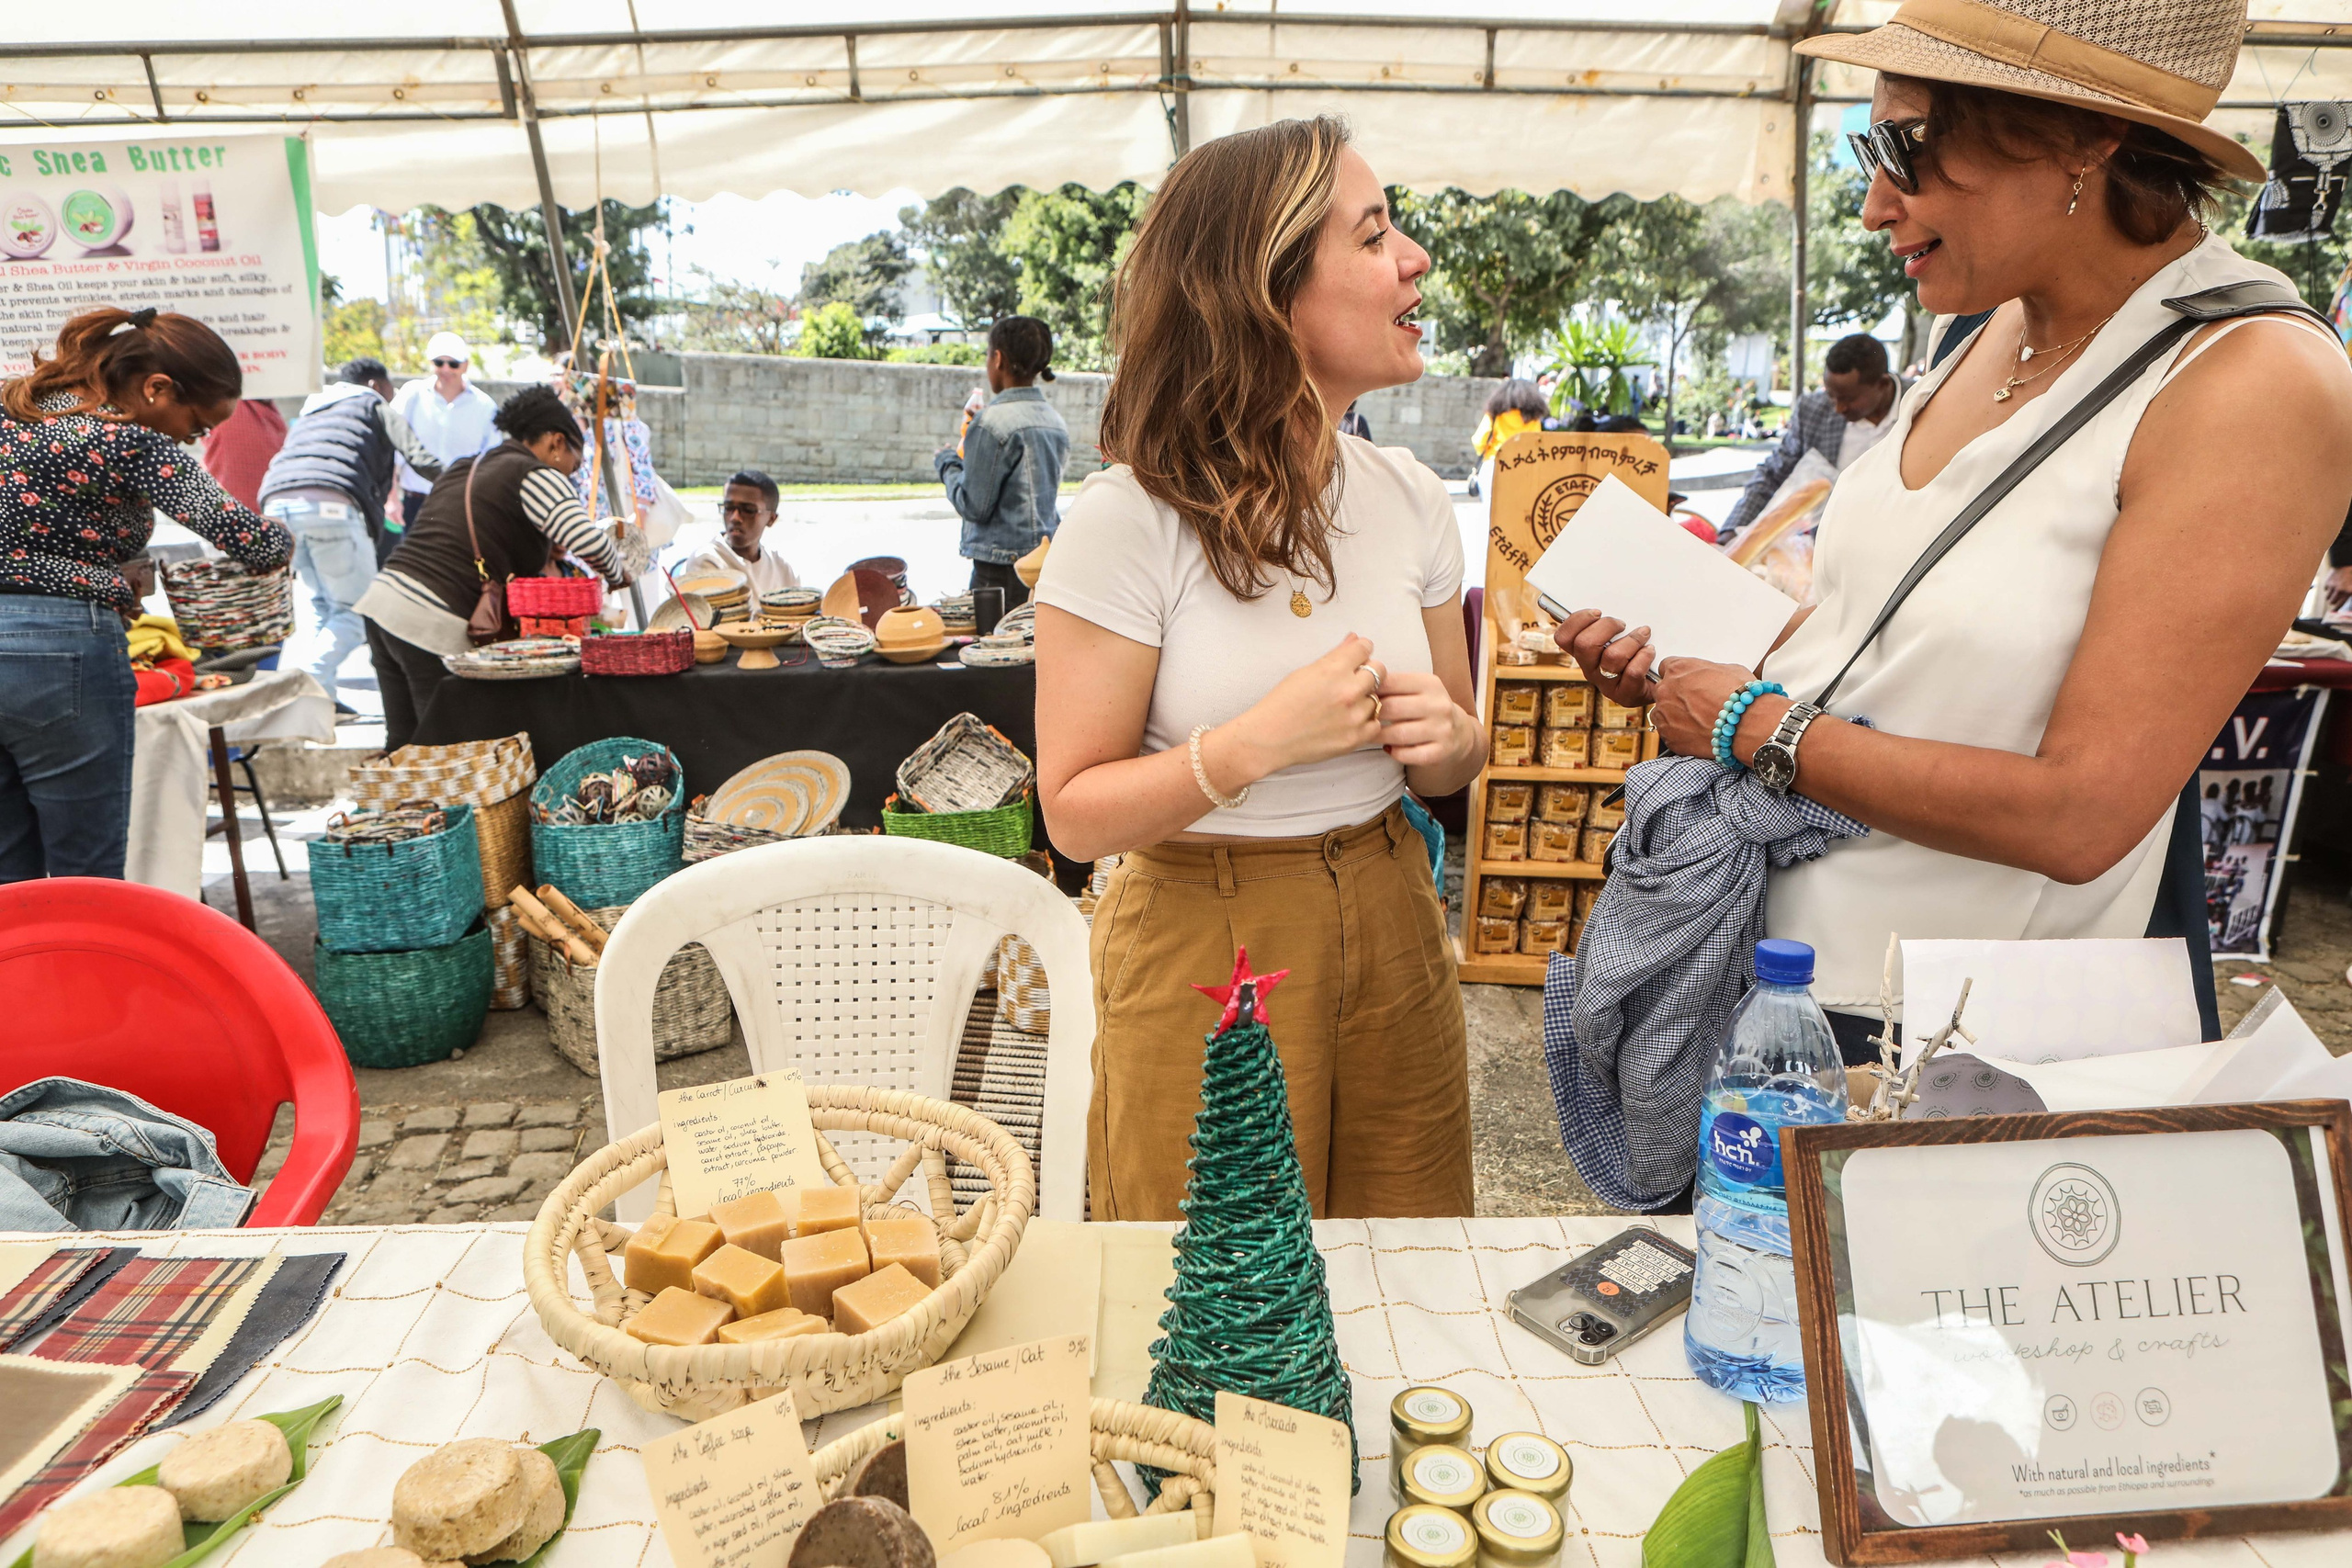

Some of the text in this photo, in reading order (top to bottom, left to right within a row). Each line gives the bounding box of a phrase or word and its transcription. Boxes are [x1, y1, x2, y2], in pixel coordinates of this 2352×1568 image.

[127, 145, 226, 172] Butter
[11, 254, 262, 276] Shea Butter & Virgin Coconut Oil
[13, 283, 23, 292] &
[27, 282, 54, 292] Shea
[58, 281, 73, 291] Oil
[76, 280, 108, 291] keeps
[112, 279, 140, 291] your
[141, 276, 166, 287] skin
[169, 276, 179, 285] &
[183, 275, 208, 285] hair
[9, 285, 292, 308] prevents wrinkles, stretch marks and damages of
[18, 310, 43, 320] skin
[1, 322, 42, 333] natural
[6, 351, 29, 360] best
[1489, 525, 1530, 571] Etafit
[678, 1092, 694, 1103] the
[784, 1070, 802, 1084] 10%
[730, 1119, 757, 1131] coconut
[696, 1135, 722, 1147] sesame
[740, 1126, 758, 1136] shea
[723, 1138, 752, 1150] sodium
[700, 1153, 723, 1164] carrot
[756, 1142, 786, 1156] papaya
[734, 1156, 767, 1168] curcuma
[731, 1172, 756, 1189] 77%
[1634, 1248, 1666, 1268] REGARDE
[1637, 1241, 1658, 1256] VIENS
[1658, 1253, 1670, 1262] TU
[1602, 1269, 1641, 1292] QUAND TU
[1606, 1261, 1655, 1291] NE SAIS PLUS
[1635, 1268, 1646, 1276] TU
[1665, 1265, 1678, 1274] ET
[1920, 1274, 2247, 1329] THE ATELIER
[1953, 1333, 2230, 1364] workshop & crafts
[939, 1367, 963, 1386] the
[1068, 1337, 1087, 1358] 9%
[913, 1399, 977, 1430] ingredients:
[953, 1420, 981, 1437] castor
[1001, 1407, 1040, 1423] sesame
[955, 1436, 978, 1450] shea
[1012, 1416, 1051, 1433] coconut
[693, 1429, 726, 1461] Coffee
[957, 1448, 981, 1467] palm
[1006, 1434, 1023, 1447] oat
[959, 1457, 993, 1476] sodium
[2011, 1461, 2045, 1483] With
[2048, 1459, 2089, 1481] natural
[2092, 1457, 2113, 1478] and
[2115, 1454, 2143, 1475] local
[992, 1477, 1030, 1505] 81%
[2034, 1487, 2055, 1497] much
[2056, 1487, 2066, 1496] as
[2067, 1484, 2098, 1497] possible
[2098, 1483, 2117, 1495] from
[2118, 1482, 2148, 1494] Ethiopia
[2150, 1480, 2165, 1489] and
[2165, 1476, 2215, 1490] surroundings
[948, 1481, 1071, 1540] local ingredients
